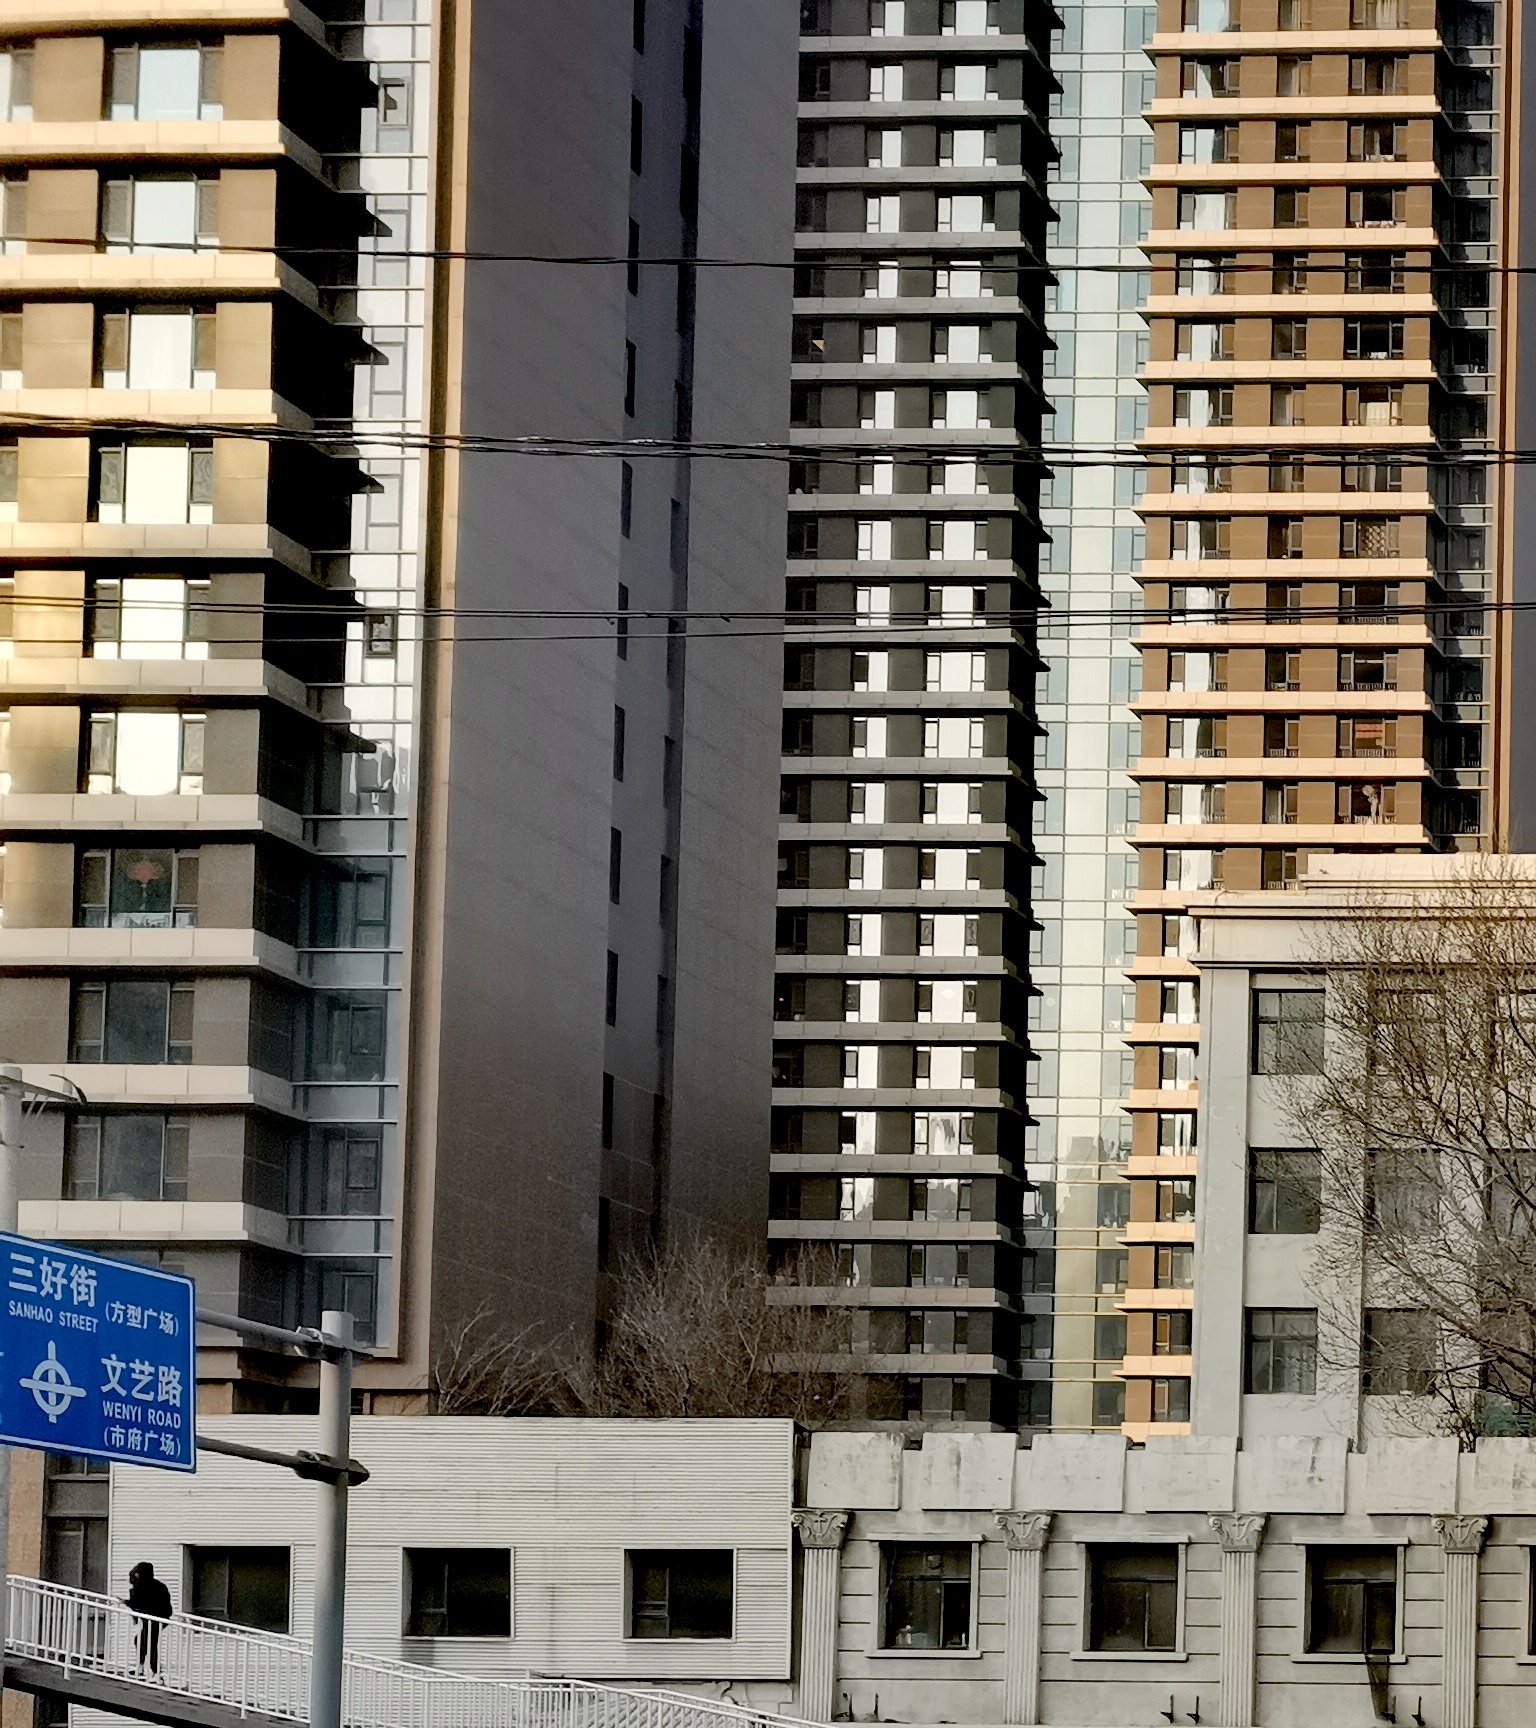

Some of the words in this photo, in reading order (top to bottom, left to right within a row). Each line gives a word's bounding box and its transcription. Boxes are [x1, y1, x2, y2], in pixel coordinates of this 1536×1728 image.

[9, 1252, 98, 1308] 三好街
[8, 1299, 54, 1324] SANHAO
[58, 1310, 99, 1334] STREET
[100, 1353, 183, 1408] 文艺路
[102, 1399, 143, 1424] WENYI
[147, 1407, 182, 1429] ROAD
